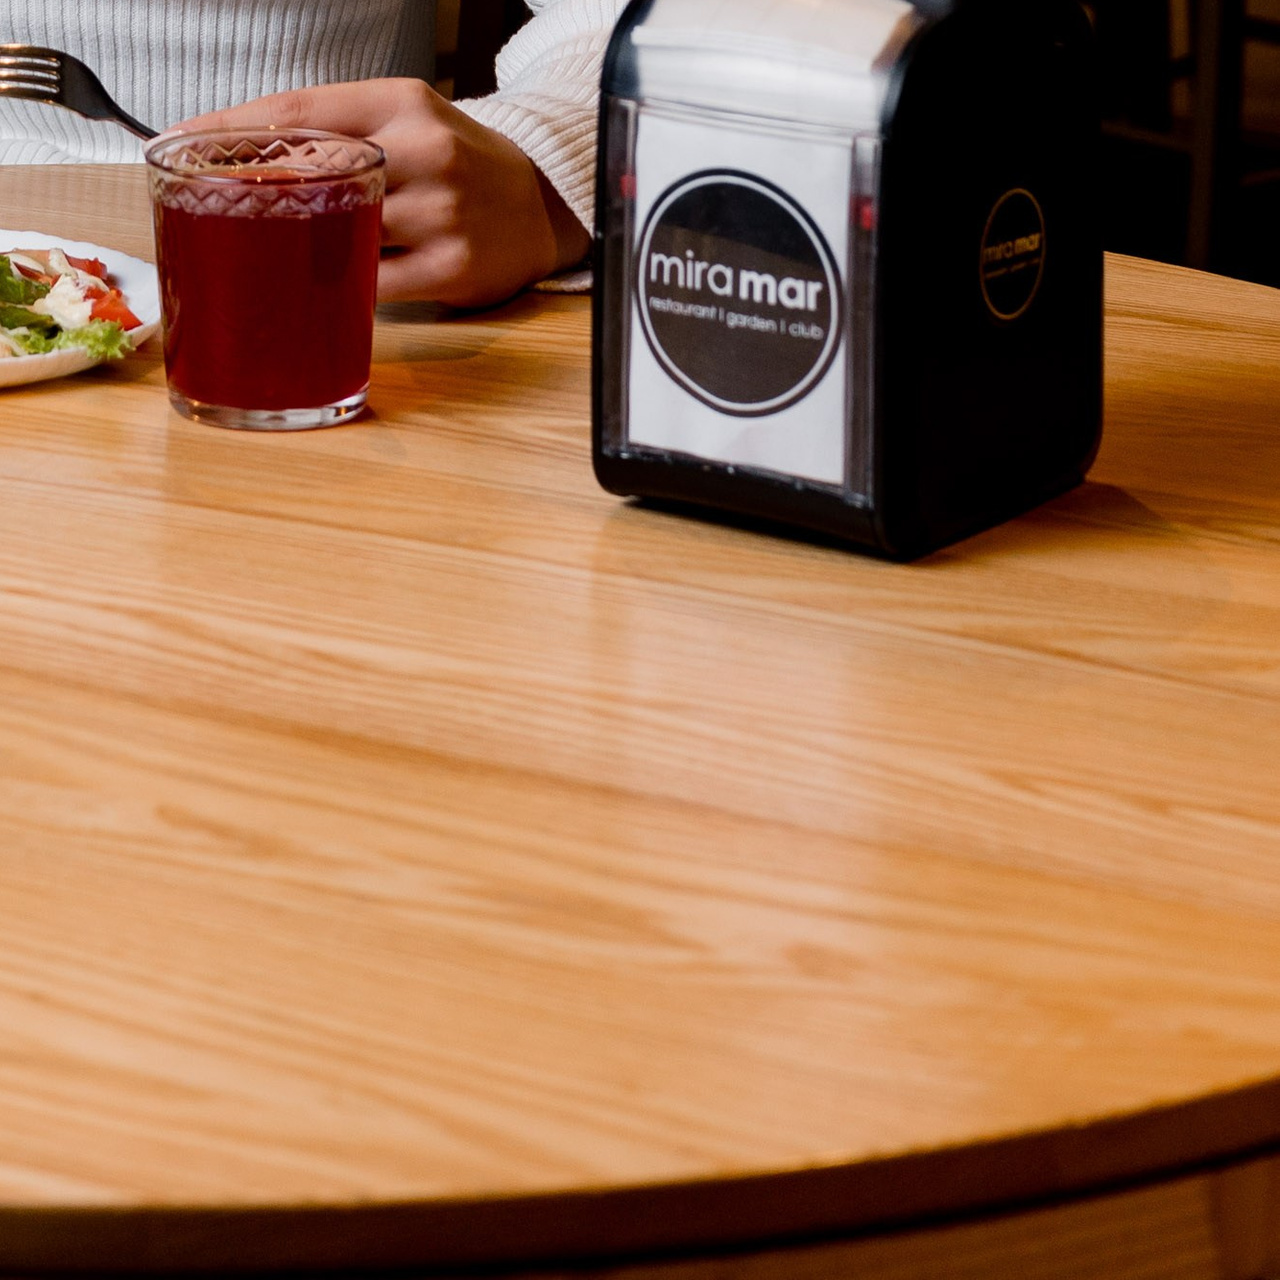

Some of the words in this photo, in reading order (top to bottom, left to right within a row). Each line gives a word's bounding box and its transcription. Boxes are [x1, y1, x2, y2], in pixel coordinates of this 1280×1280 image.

[649, 295, 717, 320] restaurant
[726, 310, 778, 331] garden
[789, 321, 824, 340] club
